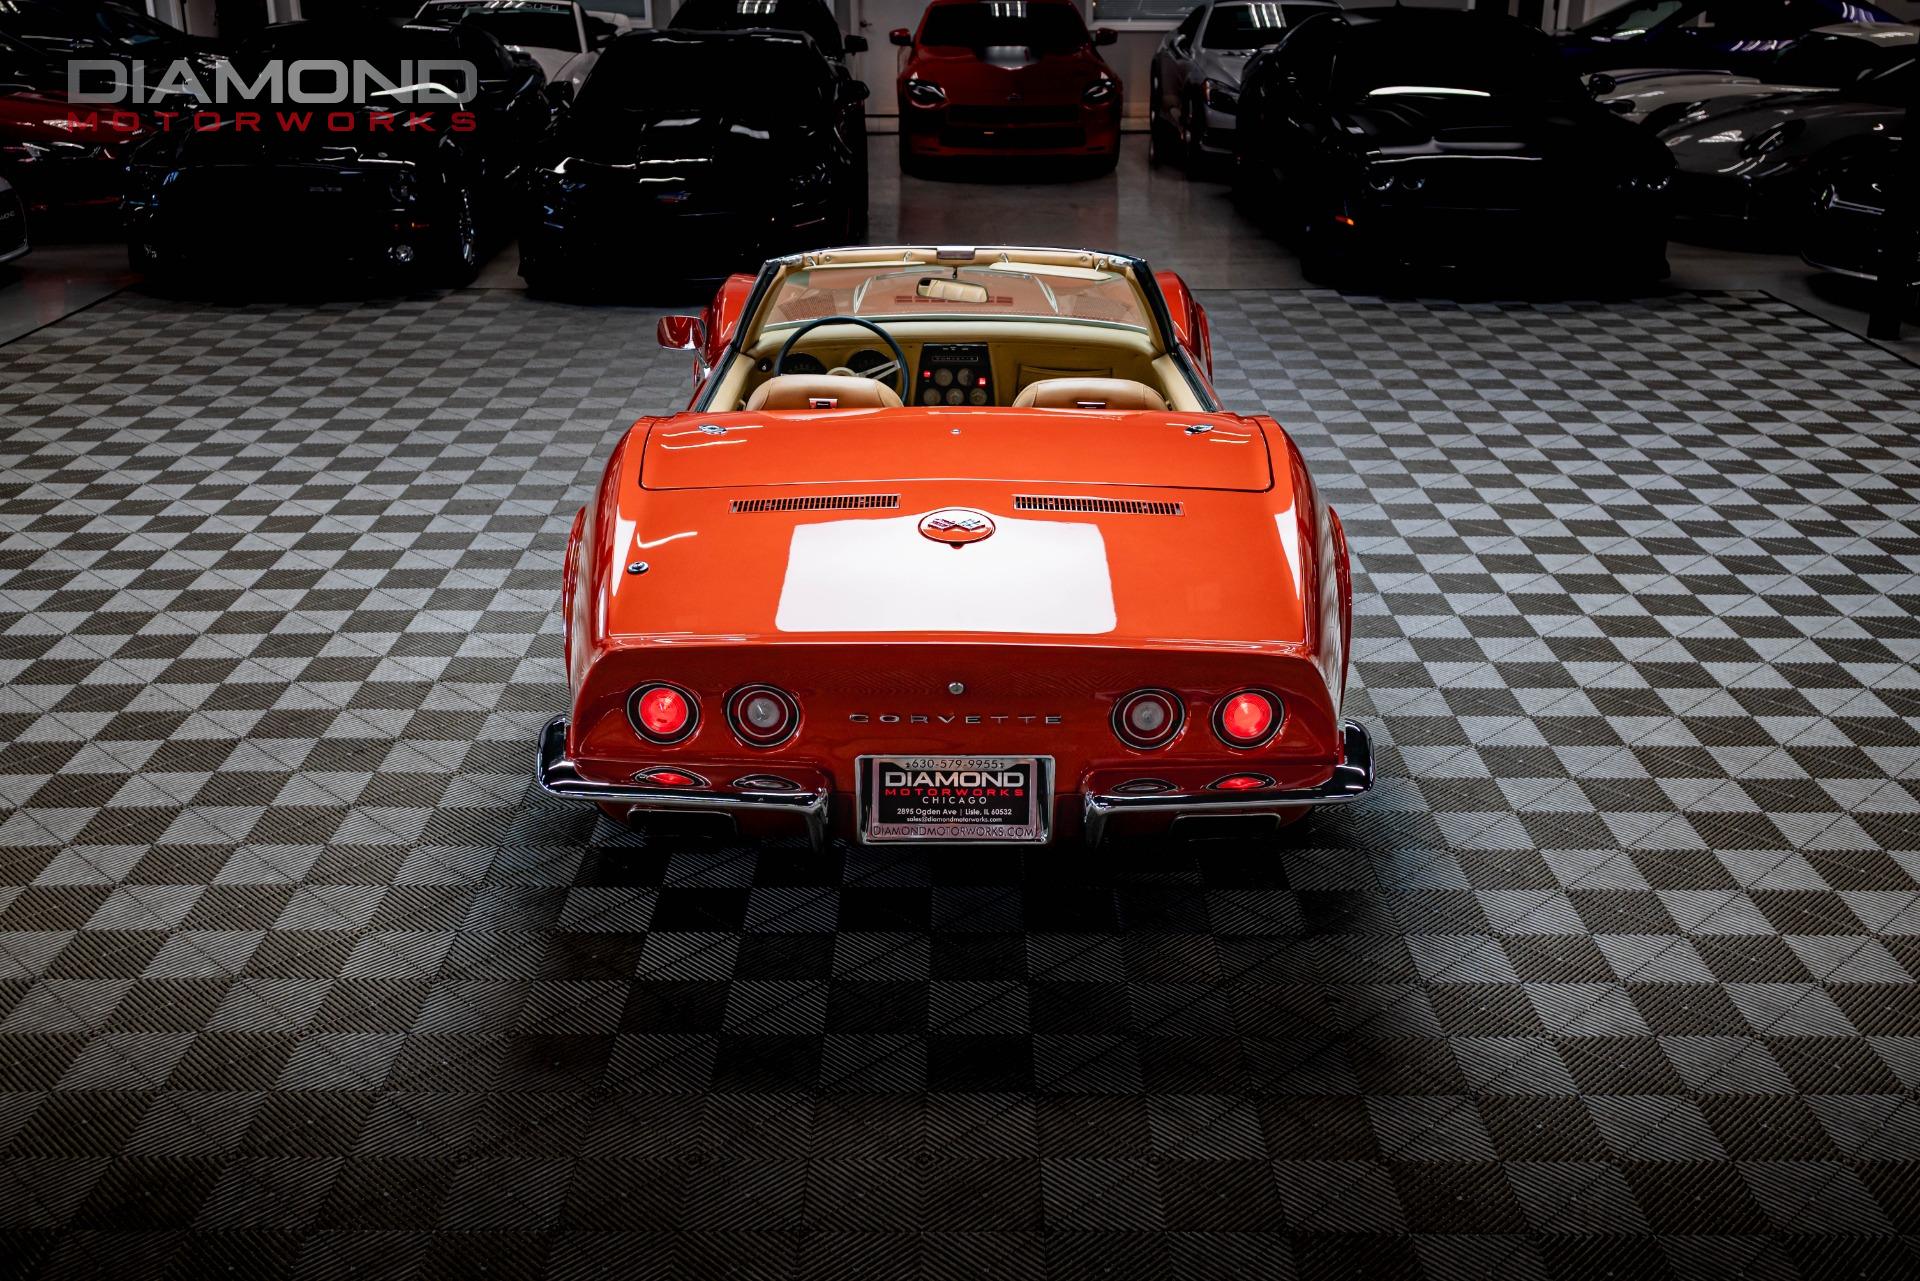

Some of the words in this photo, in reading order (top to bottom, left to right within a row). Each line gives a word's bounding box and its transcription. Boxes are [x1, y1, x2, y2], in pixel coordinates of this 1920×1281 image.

[849, 713, 1063, 724] CORVETTE
[911, 759, 999, 769] 630-579-9955
[884, 771, 1025, 788] DIAMOND
[884, 788, 1025, 797] MOTORWORKS
[922, 796, 988, 805] CHICAGO
[896, 808, 914, 816] 2895
[916, 808, 941, 817] Ogden
[942, 808, 957, 816] Ave
[983, 808, 990, 816] IL
[991, 808, 1013, 816] 60532
[873, 825, 1034, 838] DIAMONDMOTORWORKS.COM
